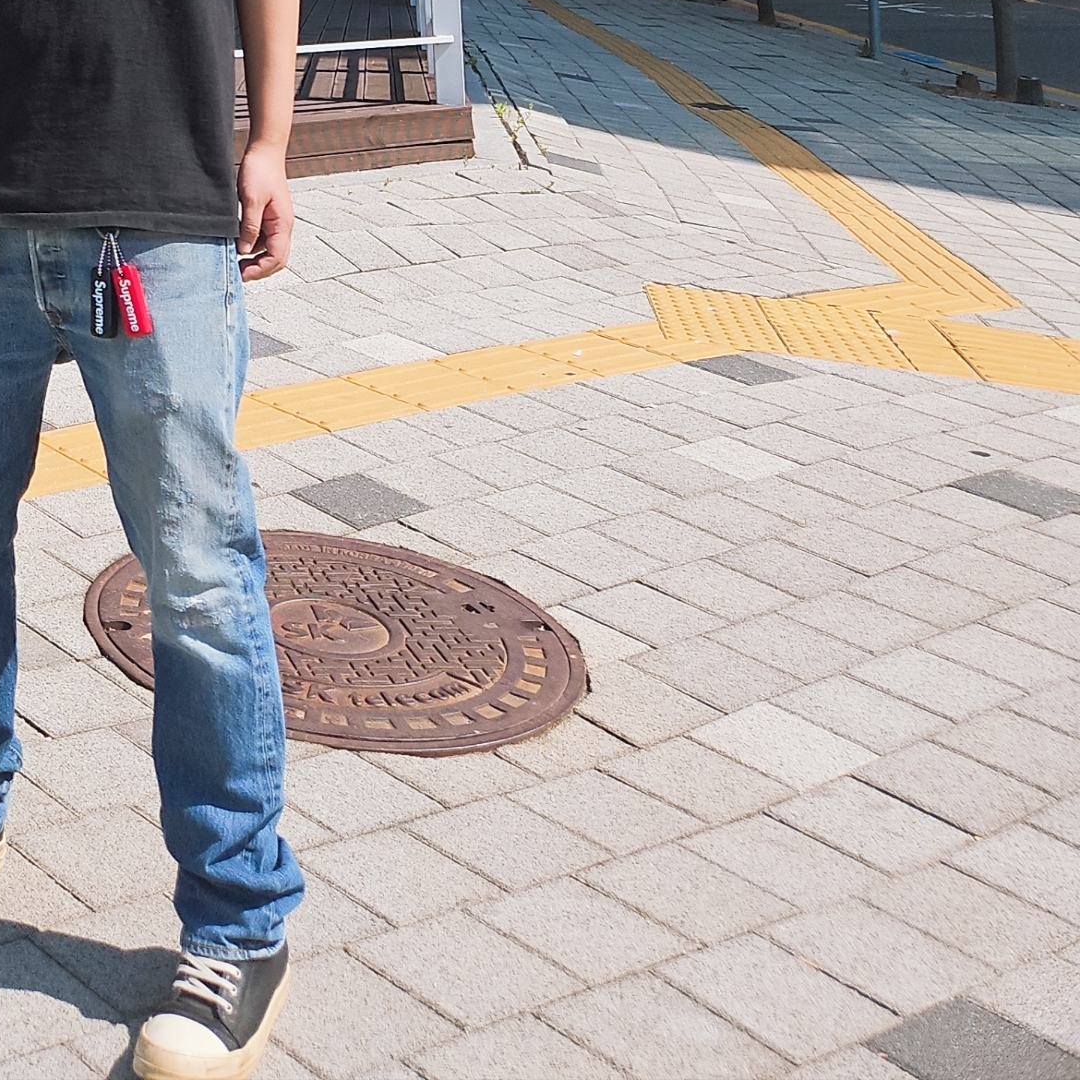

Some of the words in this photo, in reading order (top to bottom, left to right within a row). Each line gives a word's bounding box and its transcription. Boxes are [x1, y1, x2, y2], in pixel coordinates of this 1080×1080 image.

[91, 280, 107, 335] Supreme
[119, 279, 140, 333] Supreme
[281, 622, 335, 641] SK
[282, 680, 337, 706] SK
[348, 682, 470, 707] telecom
